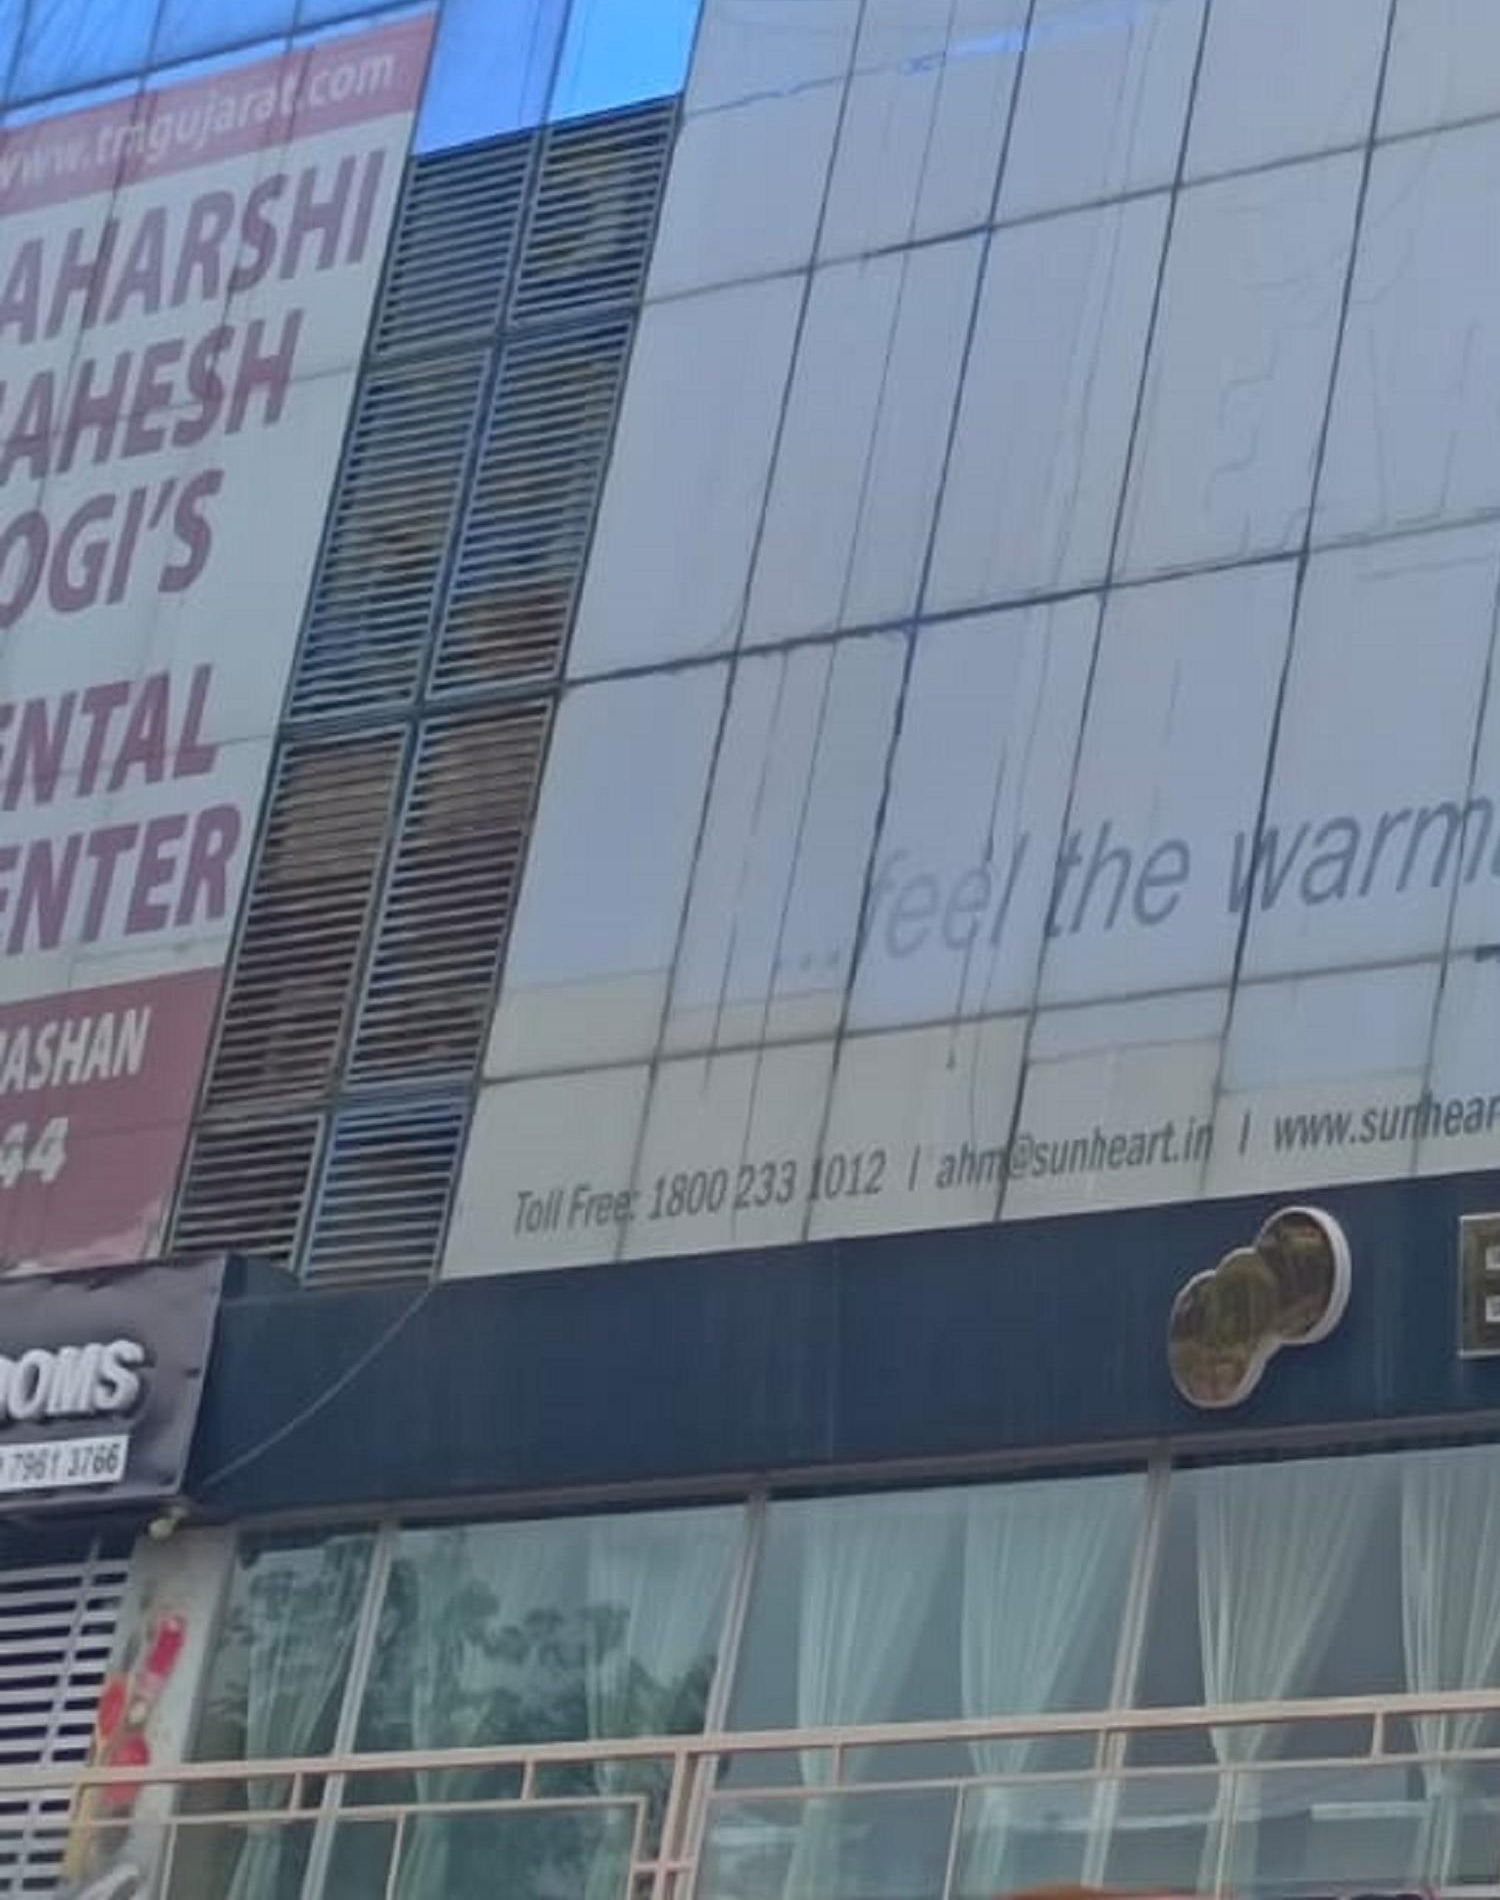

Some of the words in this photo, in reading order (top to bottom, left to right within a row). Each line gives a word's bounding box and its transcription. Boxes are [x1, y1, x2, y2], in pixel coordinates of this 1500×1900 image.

[0, 308, 303, 488] AHESH
[1043, 821, 1190, 939] the
[0, 1007, 151, 1095] ASHAN
[512, 1188, 564, 1237] Toll
[567, 1180, 637, 1231] Free:
[647, 1170, 727, 1222] 1800
[732, 1158, 796, 1210] 233
[807, 1149, 887, 1201] 1012
[936, 1116, 1214, 1192] ahm@sunheart.in
[0, 1339, 145, 1420] OMS
